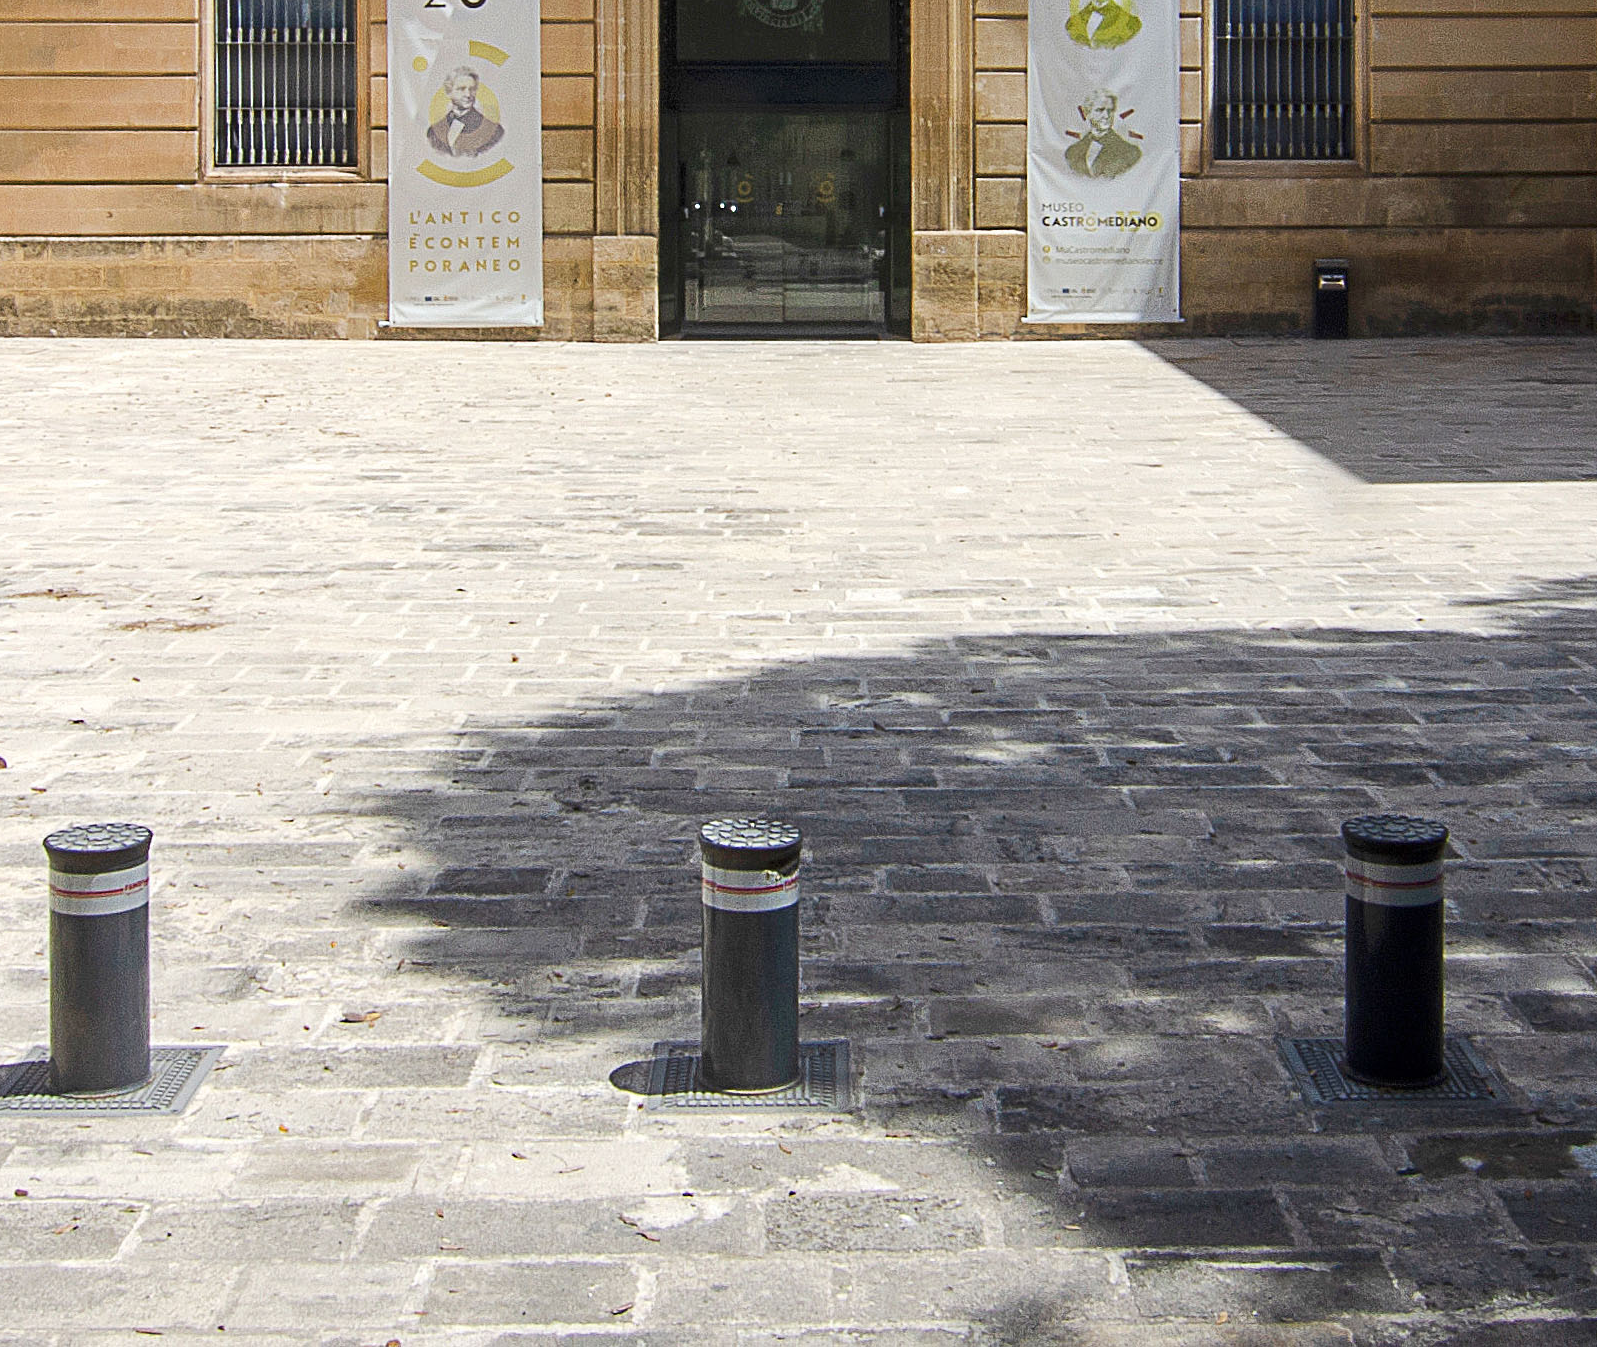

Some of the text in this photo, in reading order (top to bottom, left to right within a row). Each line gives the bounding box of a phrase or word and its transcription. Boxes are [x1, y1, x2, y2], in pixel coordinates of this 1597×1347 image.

[1041, 202, 1084, 213] MUSEO
[409, 210, 521, 225] L'ANTICO
[1042, 215, 1158, 228] CASTROMEDIANO
[409, 259, 521, 273] PORANEO
